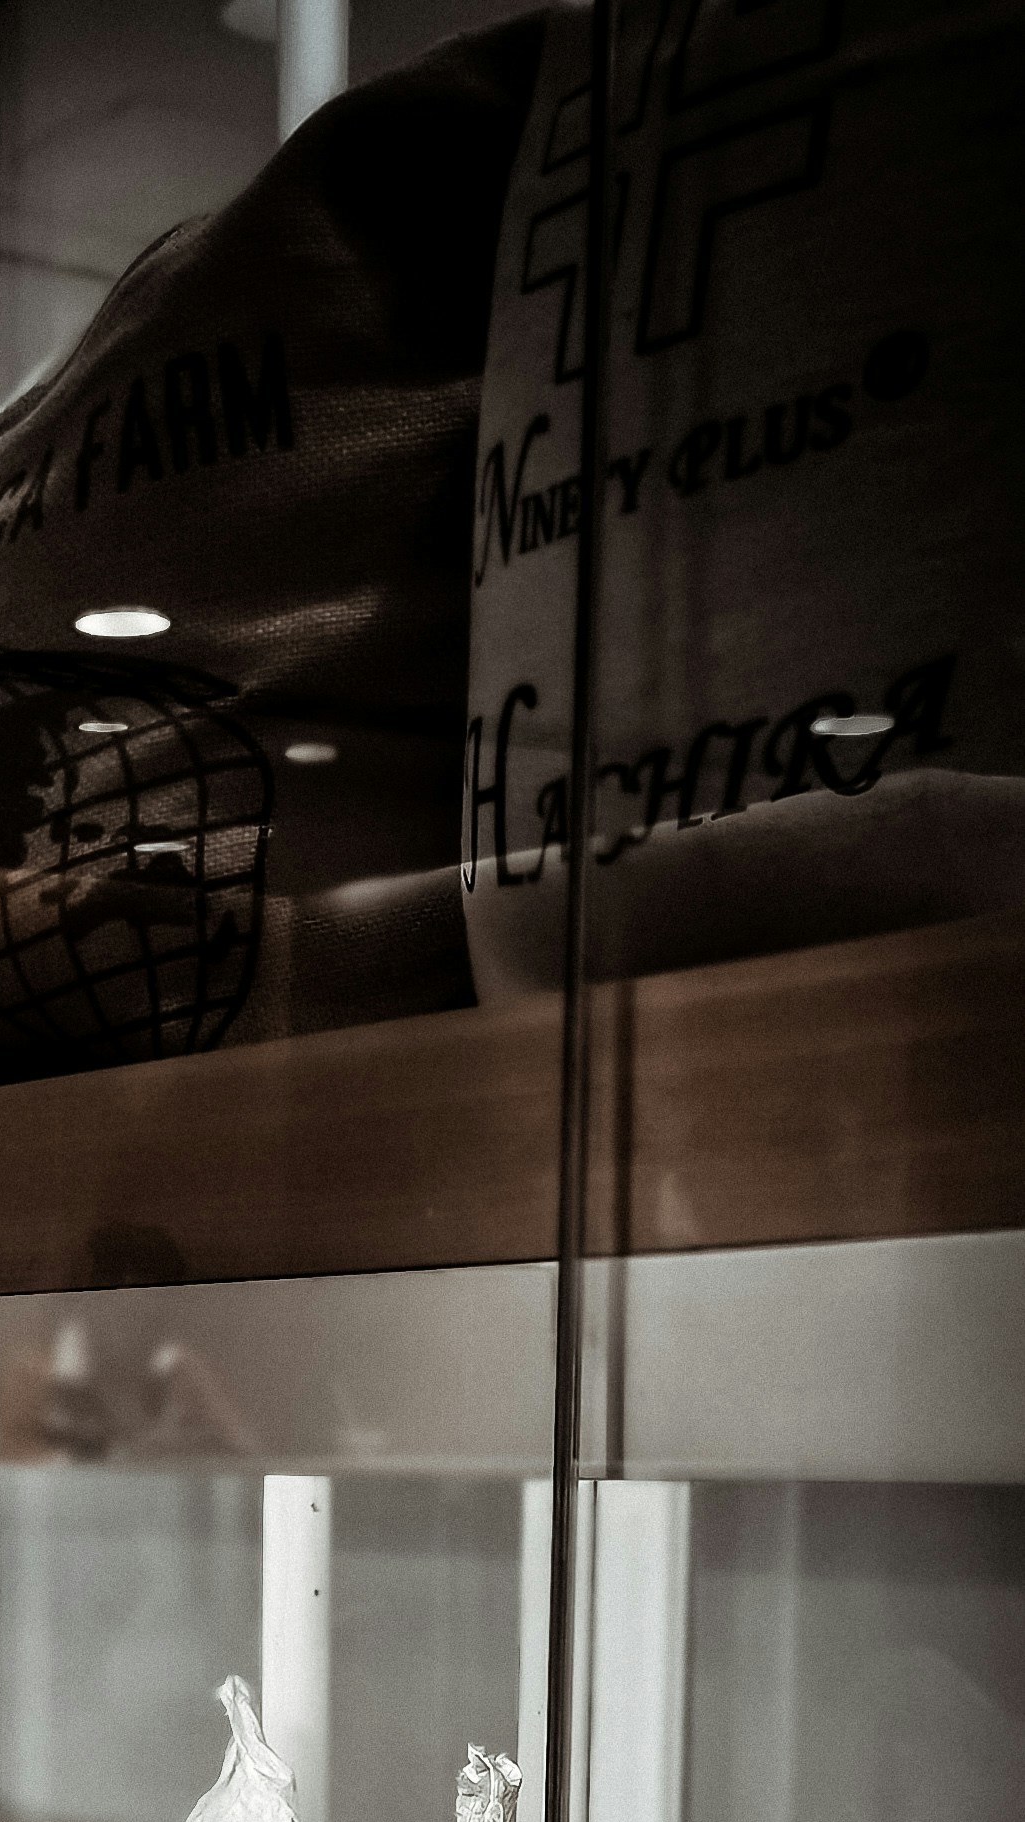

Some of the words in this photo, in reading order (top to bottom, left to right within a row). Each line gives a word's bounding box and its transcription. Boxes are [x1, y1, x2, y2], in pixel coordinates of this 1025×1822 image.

[76, 333, 294, 510] FARM
[474, 414, 651, 588] NINEY
[668, 384, 854, 498] PLUS
